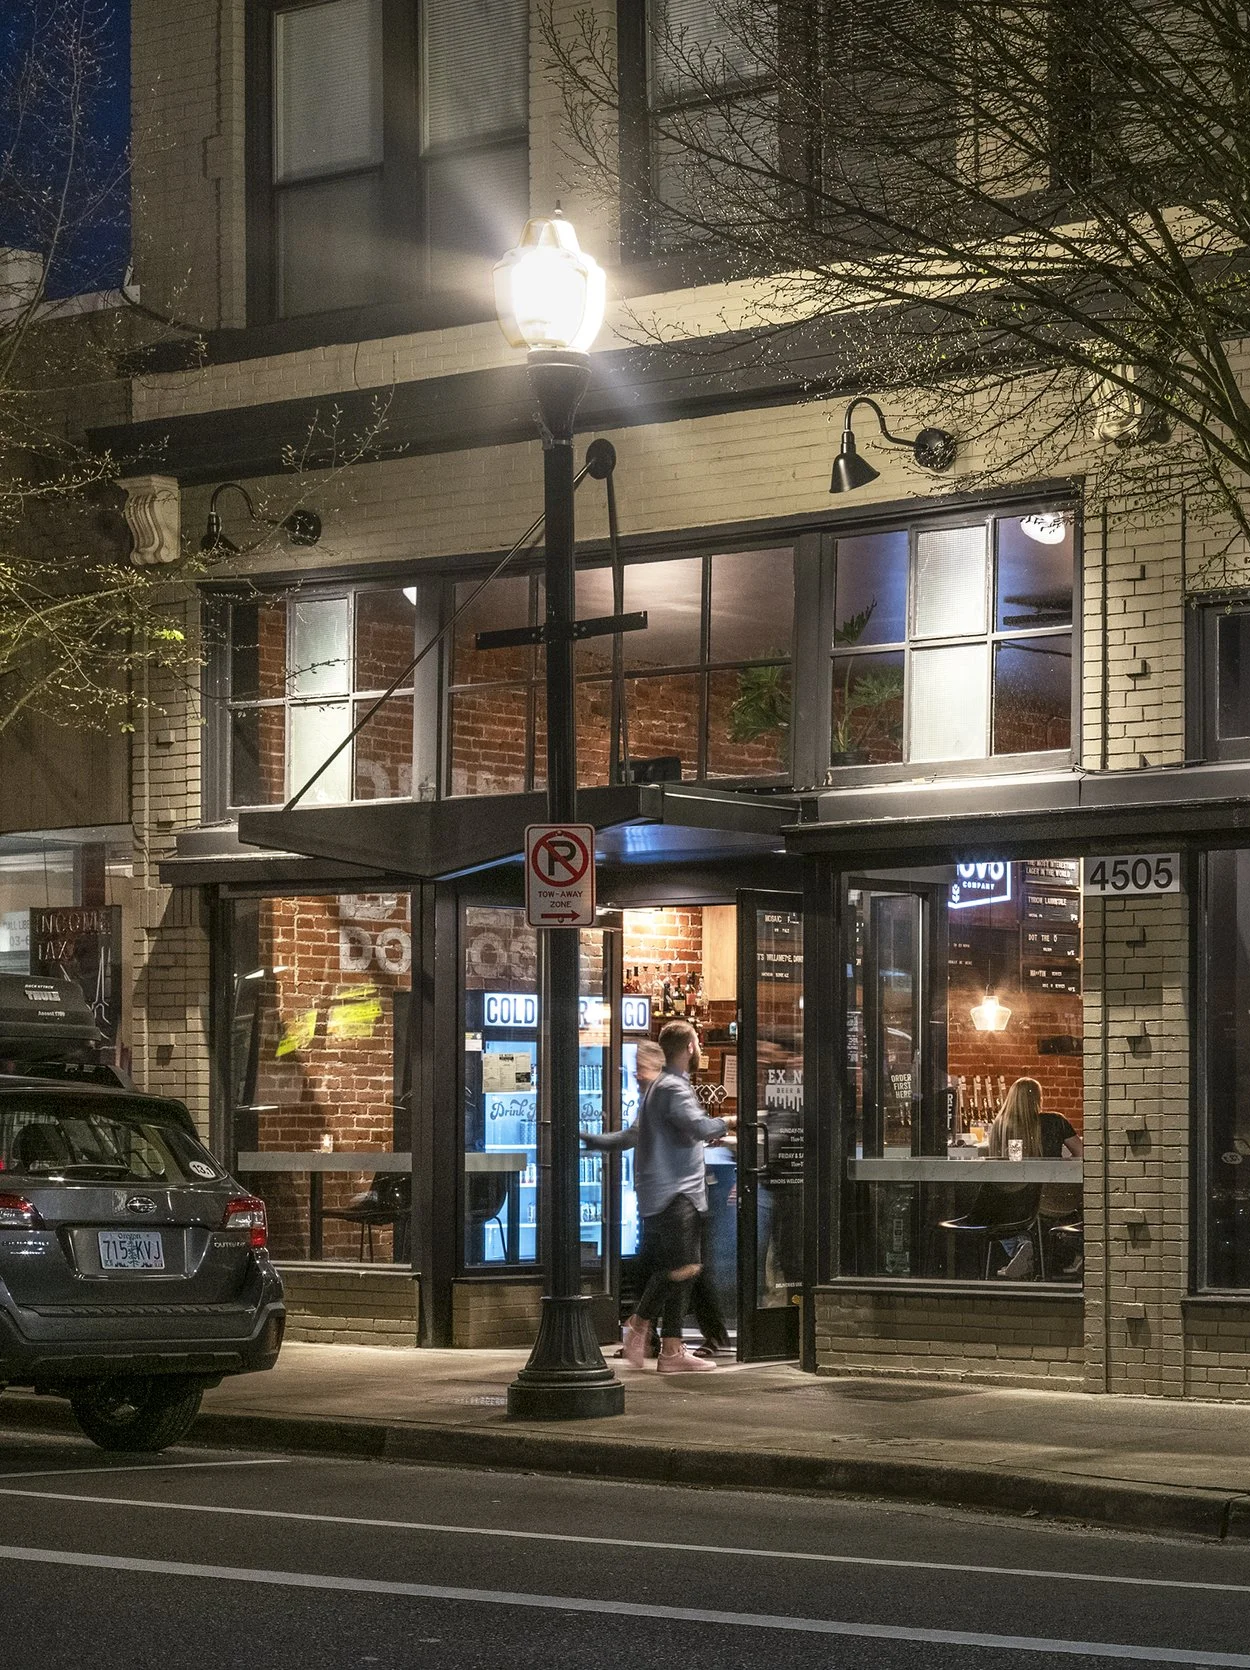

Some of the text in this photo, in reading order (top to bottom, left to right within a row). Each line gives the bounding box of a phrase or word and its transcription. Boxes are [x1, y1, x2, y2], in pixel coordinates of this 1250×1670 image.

[1089, 858, 1173, 892] 4505
[962, 881, 995, 891] COMPANY
[550, 900, 572, 908] ZONE
[36, 911, 112, 935] INCOME
[37, 940, 72, 961] TAX
[24, 990, 61, 1002] THULE
[486, 996, 535, 1025] COLD
[623, 1001, 647, 1027] GO
[768, 1069, 786, 1084] EX
[890, 1073, 912, 1083] ORDER
[893, 1081, 911, 1091] FIRST
[895, 1090, 911, 1099] HERE
[490, 1099, 528, 1120] Drink
[192, 1164, 214, 1176] 13.1
[102, 1240, 161, 1260] 715 KVJ
